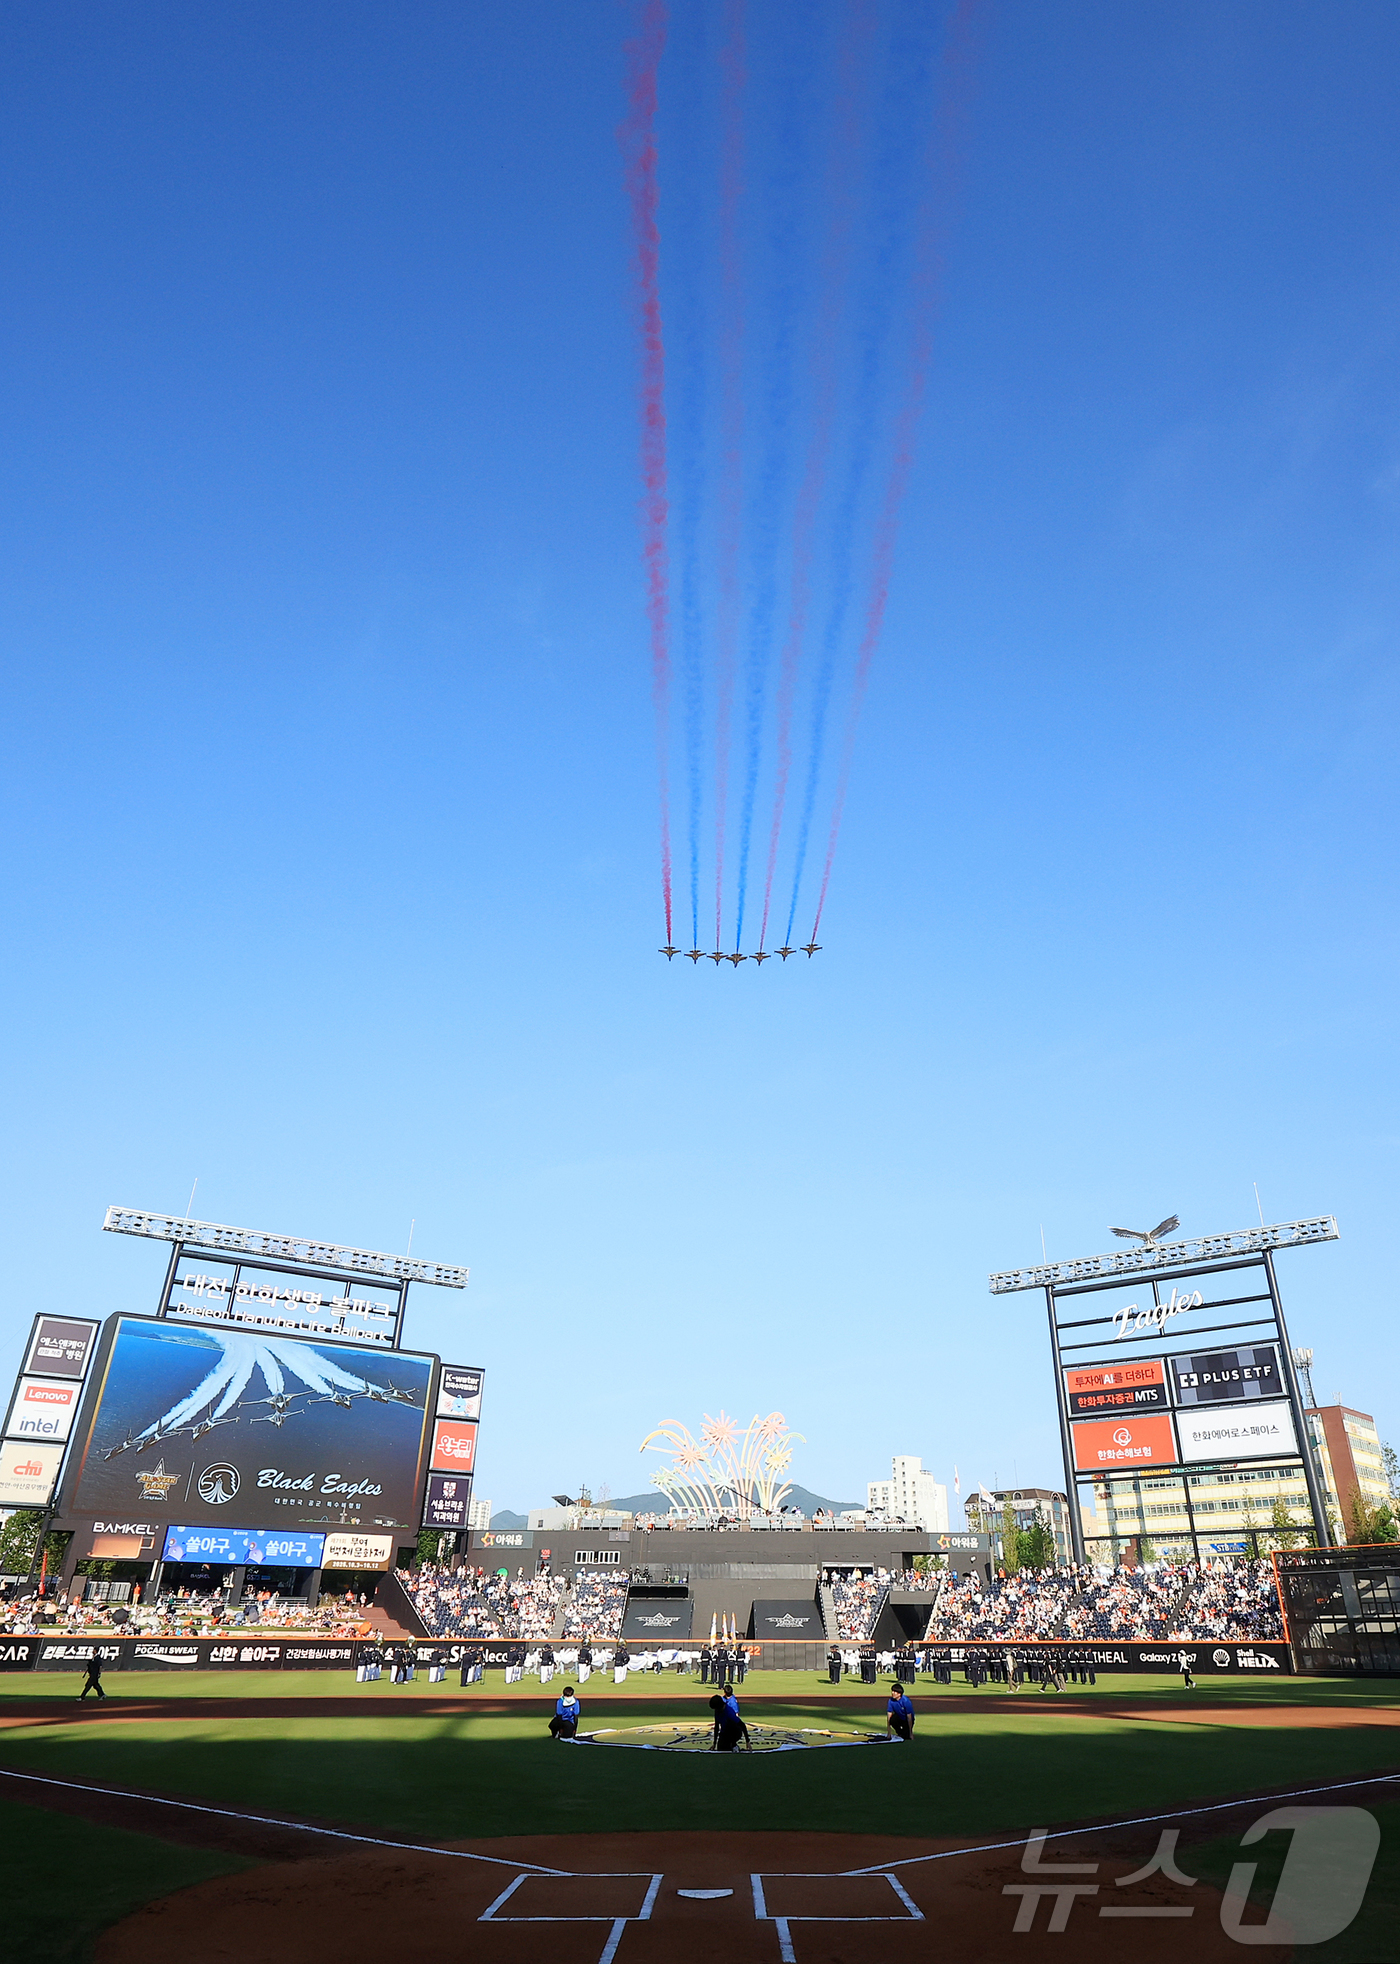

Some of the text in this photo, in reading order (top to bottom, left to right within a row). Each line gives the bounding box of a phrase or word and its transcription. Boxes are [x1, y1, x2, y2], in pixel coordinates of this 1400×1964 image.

[182, 1274, 390, 1322] 대전 한화생명 볼파크
[1112, 1288, 1204, 1340] Eagles
[176, 1302, 388, 1342] Daejeon Hanwha Life Ballpark
[40, 1337, 86, 1350] 에스엔케이
[65, 1350, 84, 1361] 병원
[445, 1373, 480, 1386] K-water
[1074, 1368, 1155, 1388] 투자에AI를 더하다
[1202, 1366, 1272, 1384] PLUS ETF
[28, 1388, 69, 1402] Lenovo
[1077, 1389, 1158, 1407] 한화투자증권 MTS
[18, 1416, 60, 1434] intel
[1192, 1425, 1280, 1442] 한화에어로스페이스
[437, 1435, 472, 1456] 온누리
[1097, 1446, 1152, 1460] 한화손해보험
[257, 1468, 382, 1499] Black Eagles
[430, 1500, 464, 1512] 서울브라운
[432, 1511, 460, 1523] 치과의원
[92, 1522, 156, 1535] BAMKEL
[186, 1536, 230, 1554] 쏠야구
[351, 1537, 369, 1546] 부여
[496, 1534, 524, 1546] 아워홈
[952, 1536, 979, 1549] 아워홈
[265, 1540, 307, 1557] 쏠야구
[329, 1546, 386, 1558] 백제문화제
[134, 1646, 199, 1655] POCARI SWEAT
[210, 1646, 280, 1662] 신한 쏠야구
[286, 1648, 351, 1660] 건강보험심사평가원
[1236, 1648, 1254, 1657] Shell
[1139, 1652, 1171, 1664] Galaxy
[1171, 1652, 1178, 1662] Z
[1238, 1655, 1280, 1668] HELIX
